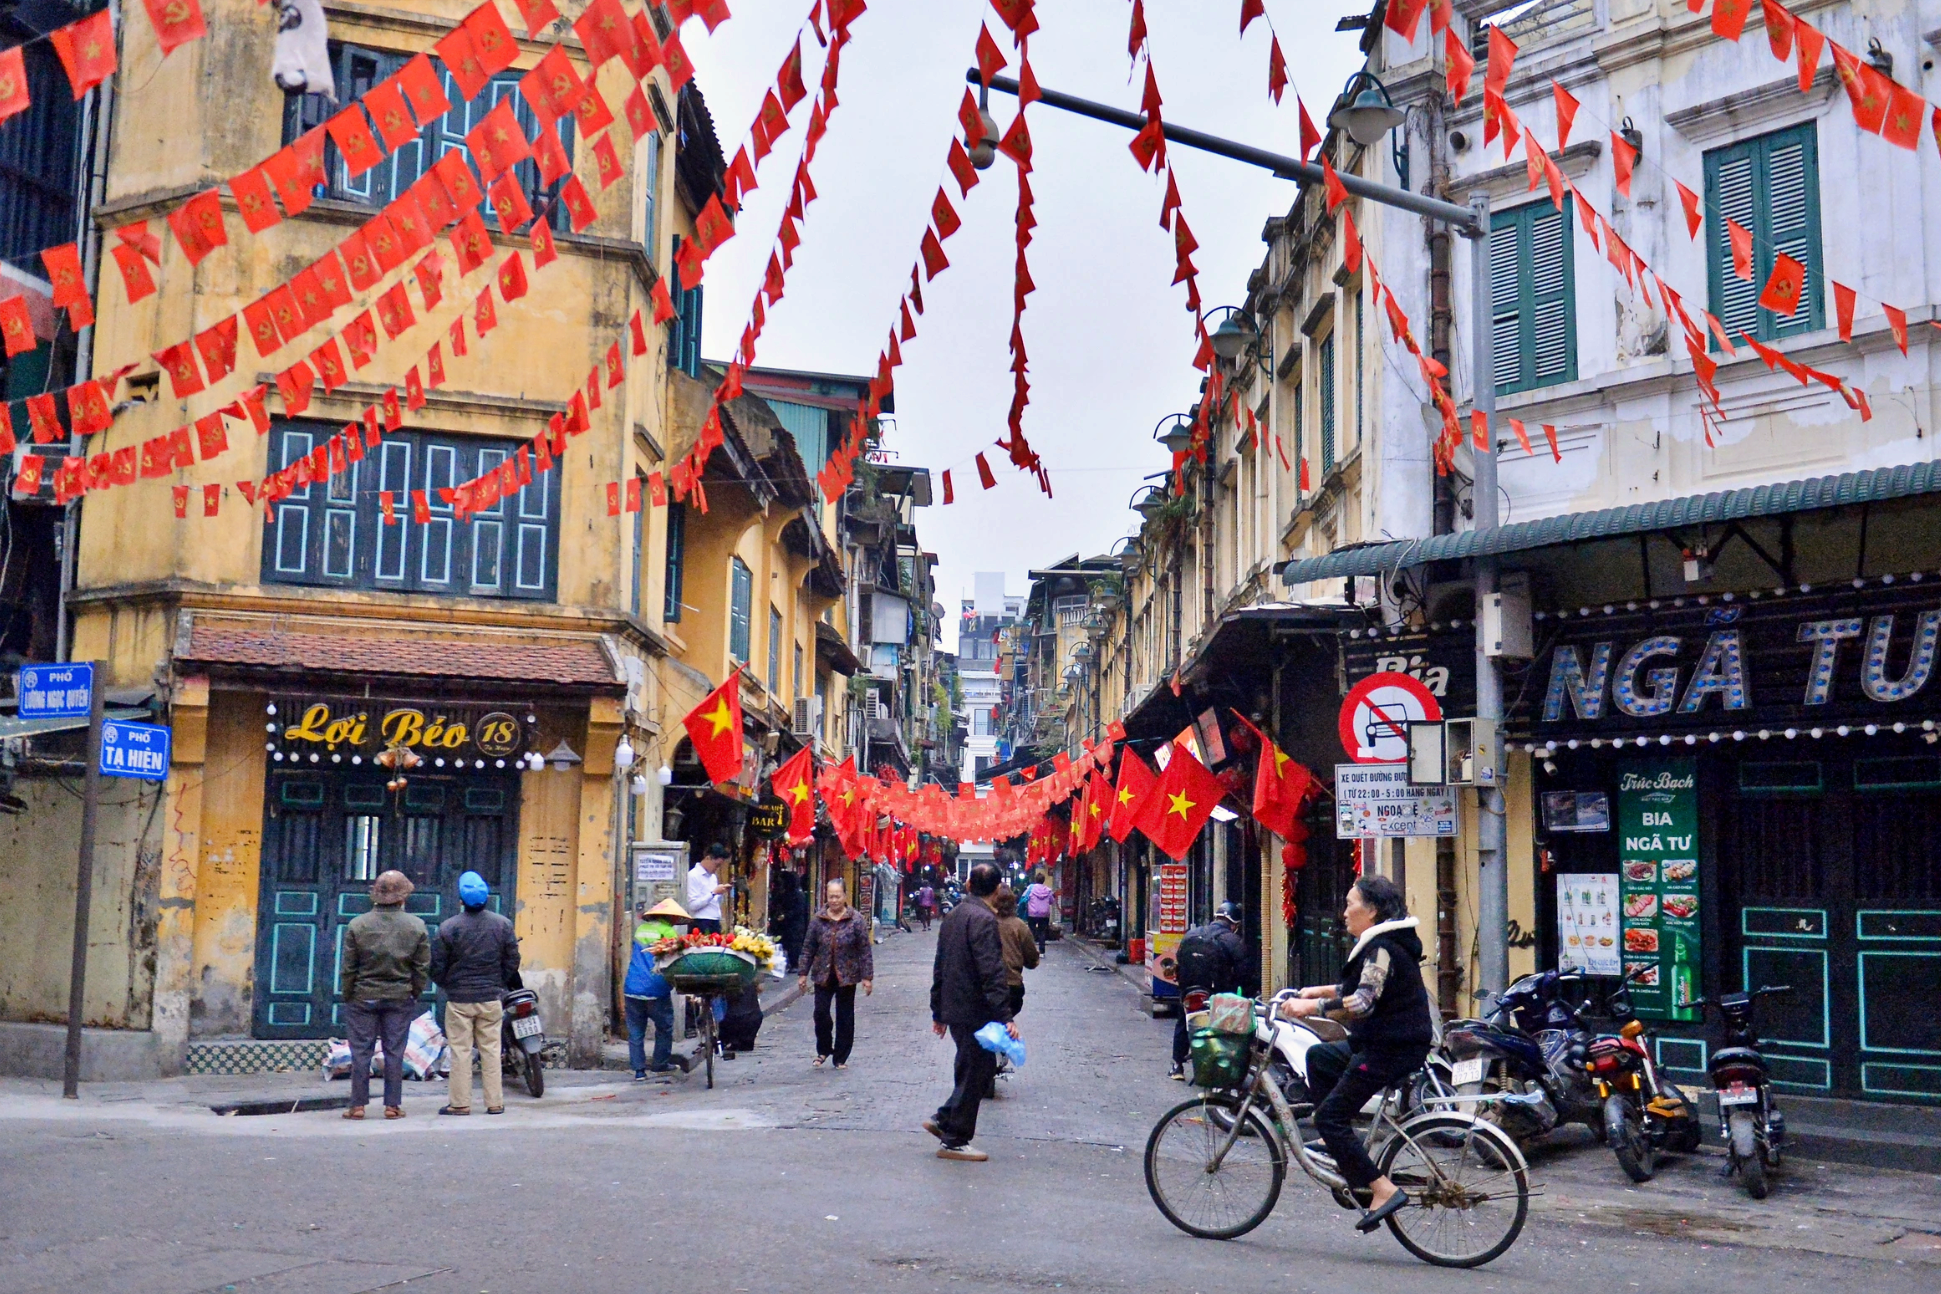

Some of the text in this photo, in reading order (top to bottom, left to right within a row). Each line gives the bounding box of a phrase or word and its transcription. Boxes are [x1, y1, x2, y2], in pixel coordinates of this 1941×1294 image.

[1541, 606, 1748, 722] NGÃ
[49, 668, 73, 682] PHỐ
[285, 703, 469, 751] Lợi Béo
[482, 721, 515, 743] 18
[128, 730, 152, 743] PHỐ
[105, 746, 162, 772] TẠ HIỆN
[1341, 774, 1349, 783] XE
[1621, 772, 1694, 791] Trúc Bạch
[752, 817, 774, 826] BAR
[1642, 812, 1673, 826] BIA
[1626, 834, 1692, 851] NGÃ TƯ
